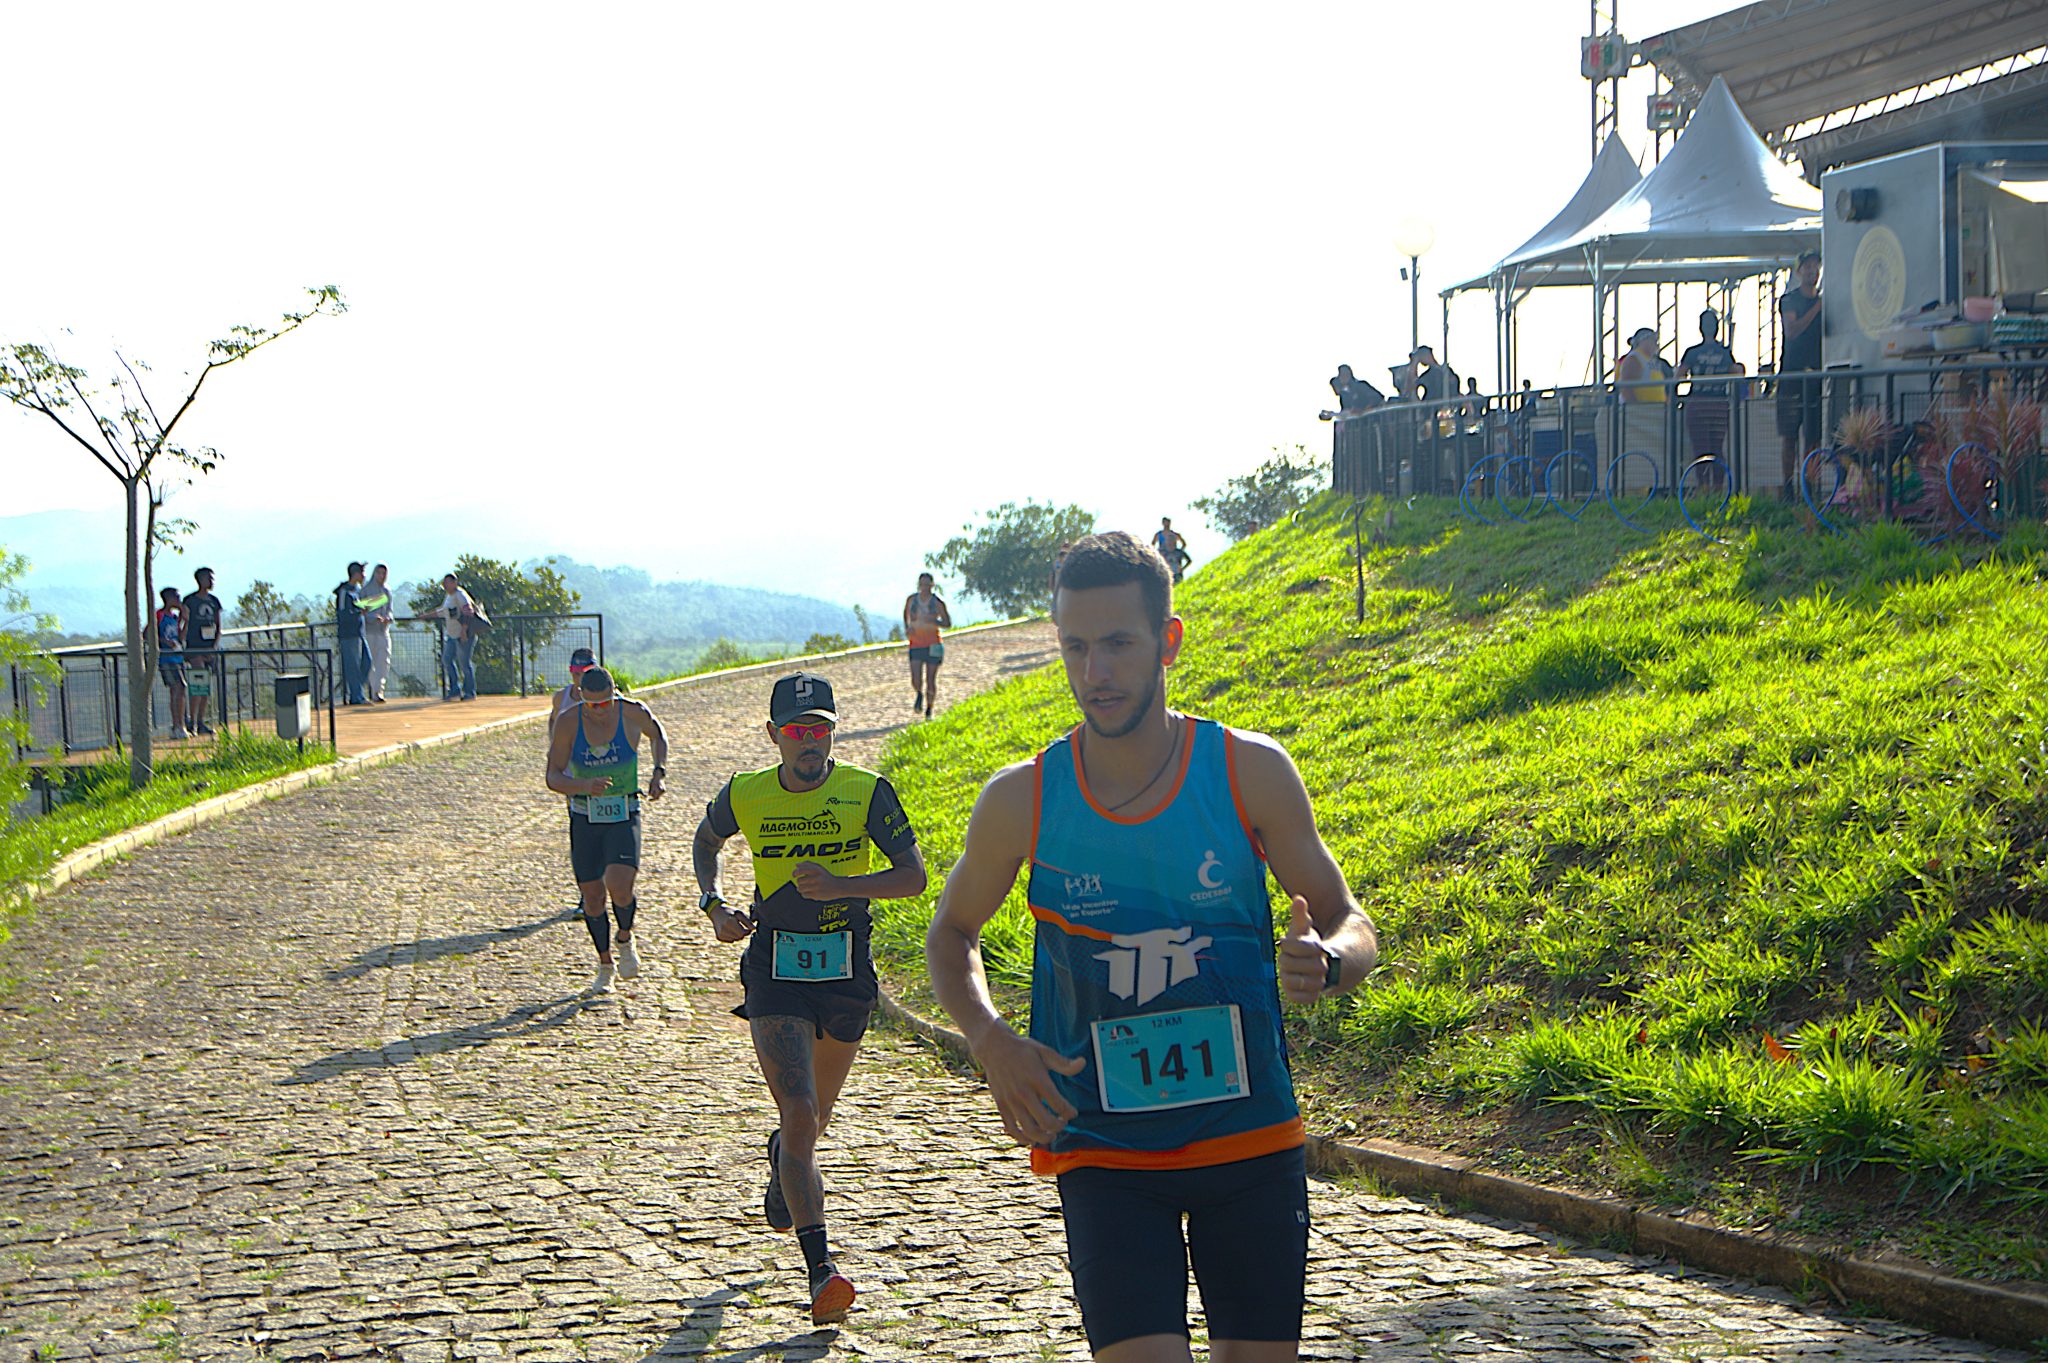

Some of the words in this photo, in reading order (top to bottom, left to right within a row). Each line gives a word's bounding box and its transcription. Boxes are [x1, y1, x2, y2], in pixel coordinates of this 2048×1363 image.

[596, 804, 620, 817] 203
[759, 818, 829, 833] MAGMOTOS
[788, 829, 834, 838] MULTIMARCAS
[830, 854, 858, 865] RACE
[1081, 899, 1119, 909] Incentivo
[797, 949, 827, 970] 91
[1151, 1017, 1164, 1029] 12
[1165, 1015, 1183, 1027] KM
[1130, 1039, 1214, 1086] 141
